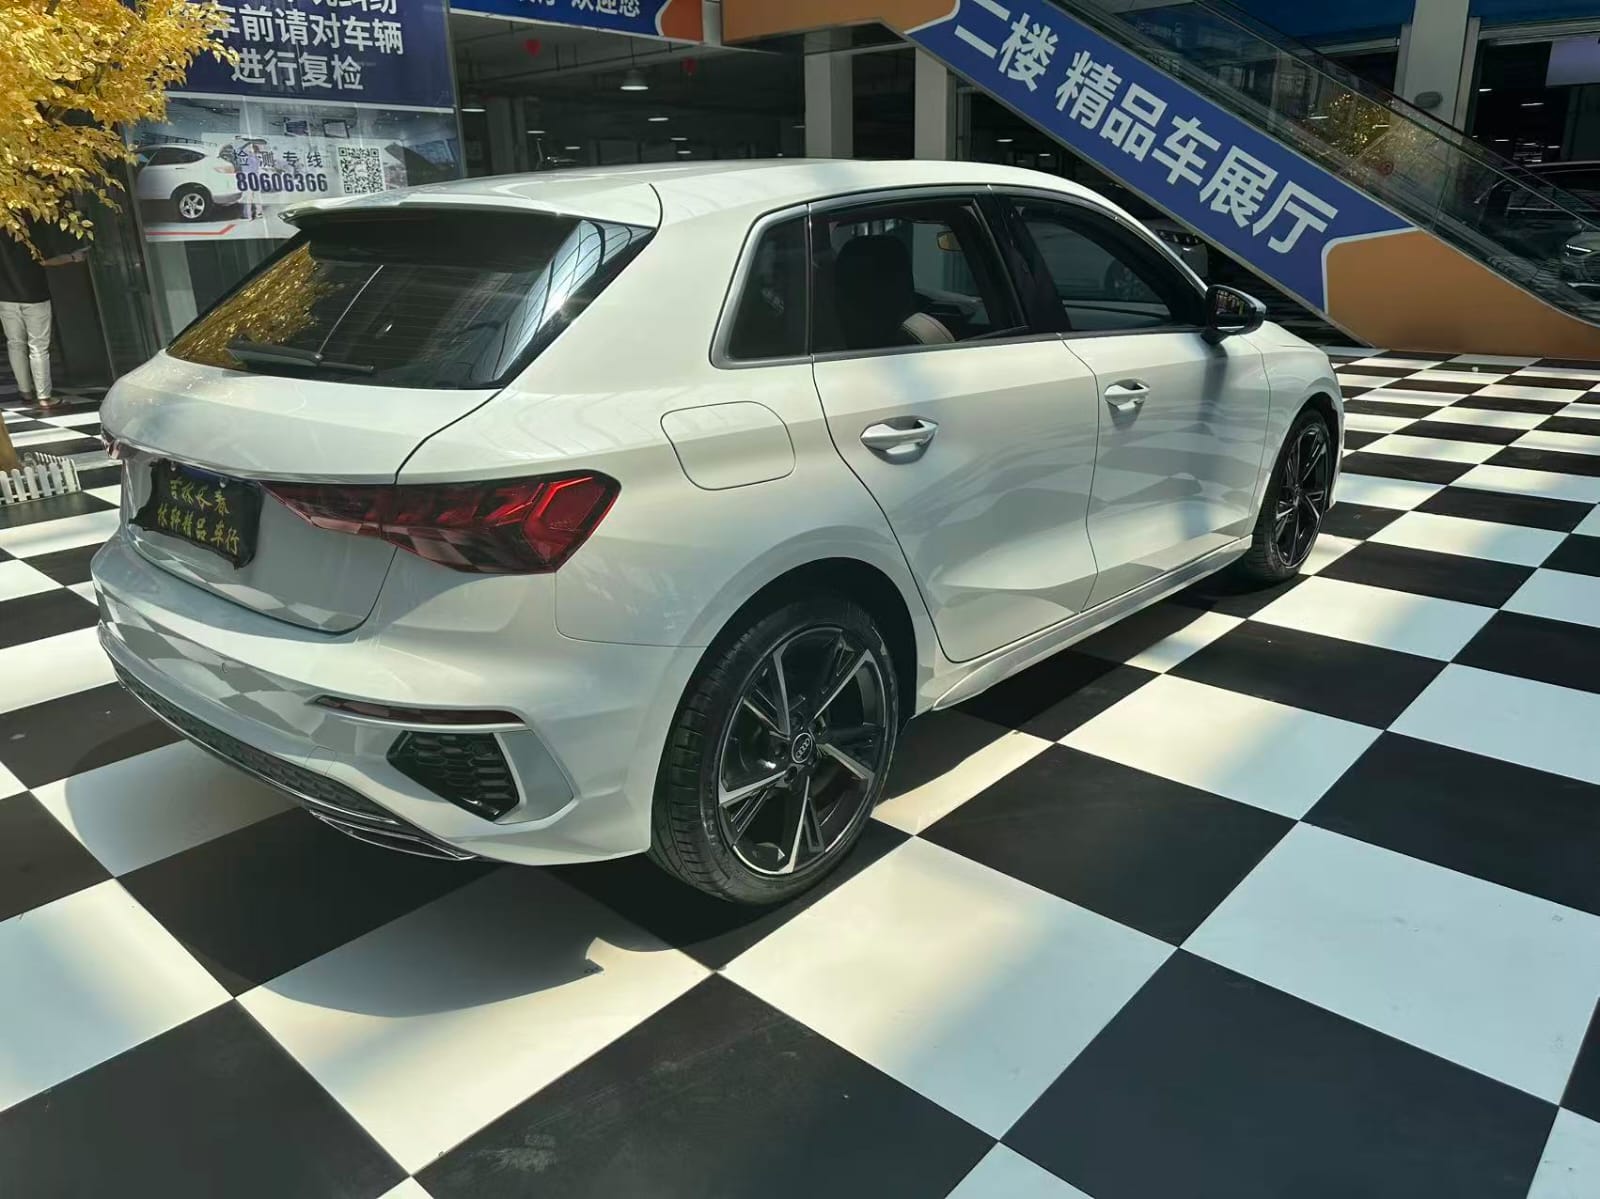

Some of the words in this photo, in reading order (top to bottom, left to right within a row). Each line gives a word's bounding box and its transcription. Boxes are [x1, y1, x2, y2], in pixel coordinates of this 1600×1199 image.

[231, 46, 364, 91] 进行复检
[954, 0, 1058, 92] 二楼
[1055, 49, 1338, 254] 精品车展厅
[232, 149, 323, 168] 检测专线
[236, 172, 329, 193] 80606366
